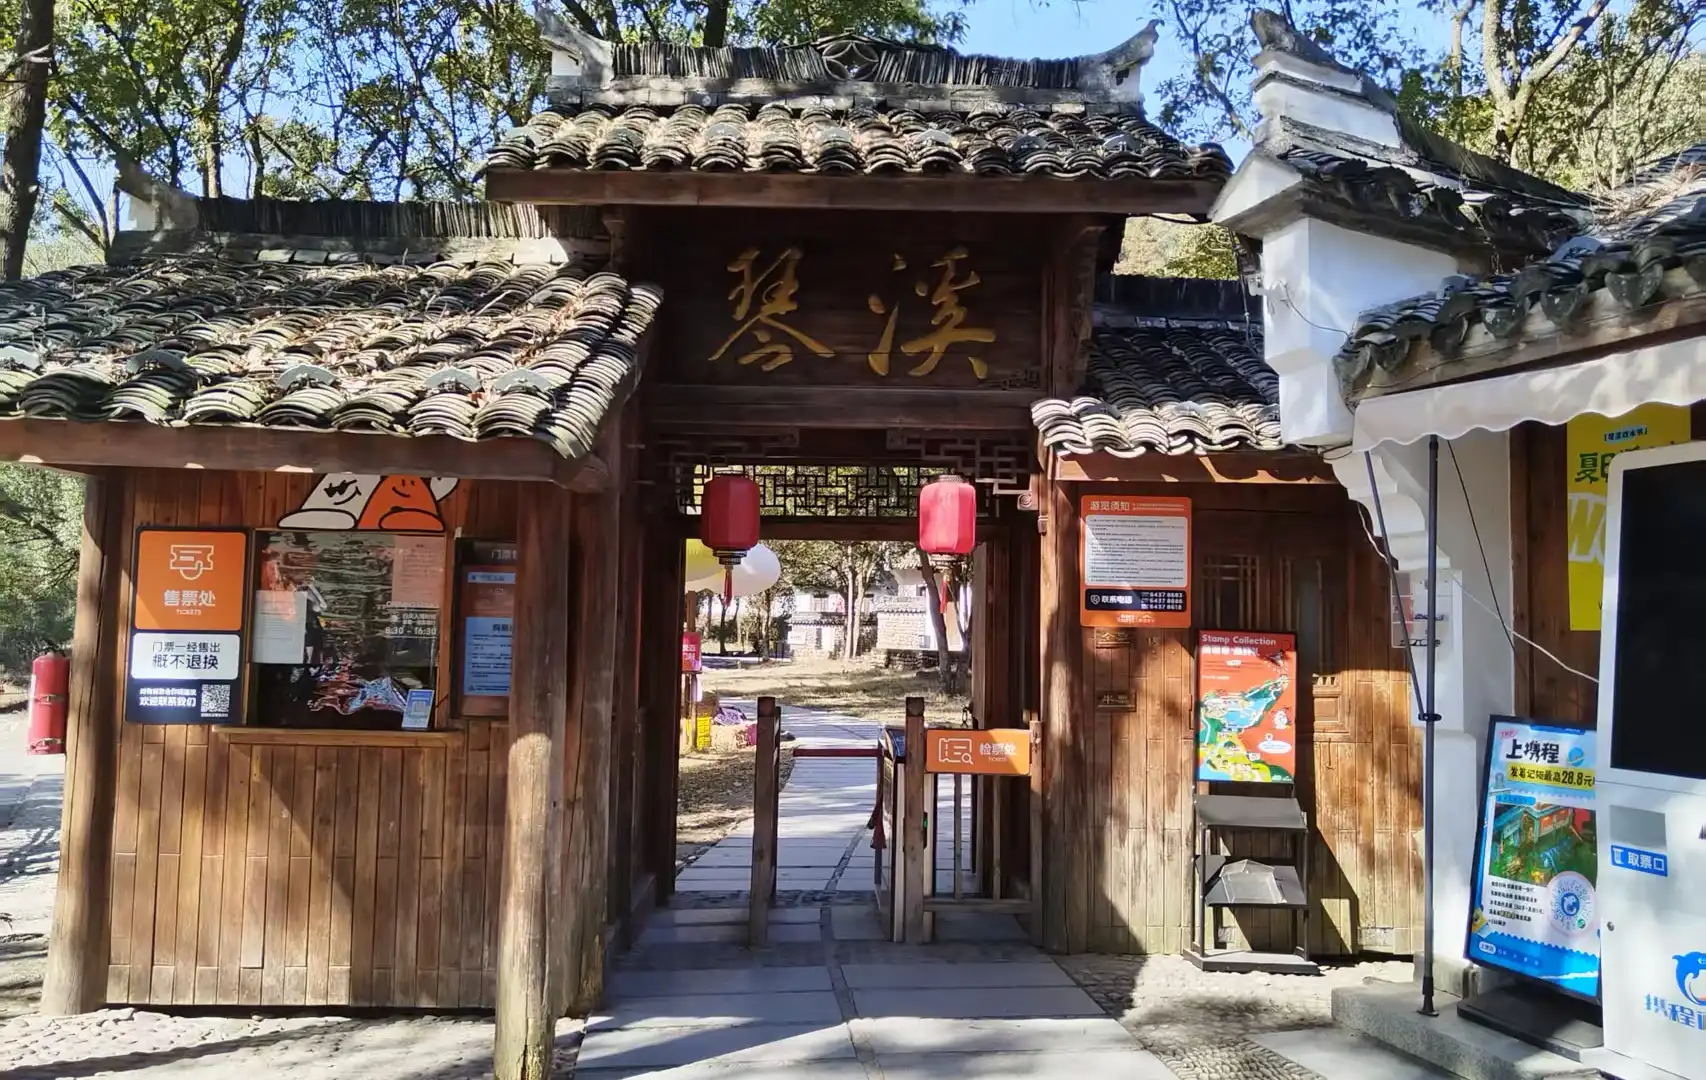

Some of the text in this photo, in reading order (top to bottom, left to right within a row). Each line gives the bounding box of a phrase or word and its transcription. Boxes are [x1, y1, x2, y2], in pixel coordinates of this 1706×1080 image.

[164, 590, 216, 607] 售票处
[1202, 634, 1277, 647] Stamp Collection
[152, 641, 221, 654] 门票一经售出
[152, 653, 220, 671] 概不退换
[139, 696, 197, 708] 欢迎联系我们
[980, 743, 1017, 756] 检票处
[1627, 851, 1665, 872] 取票口
